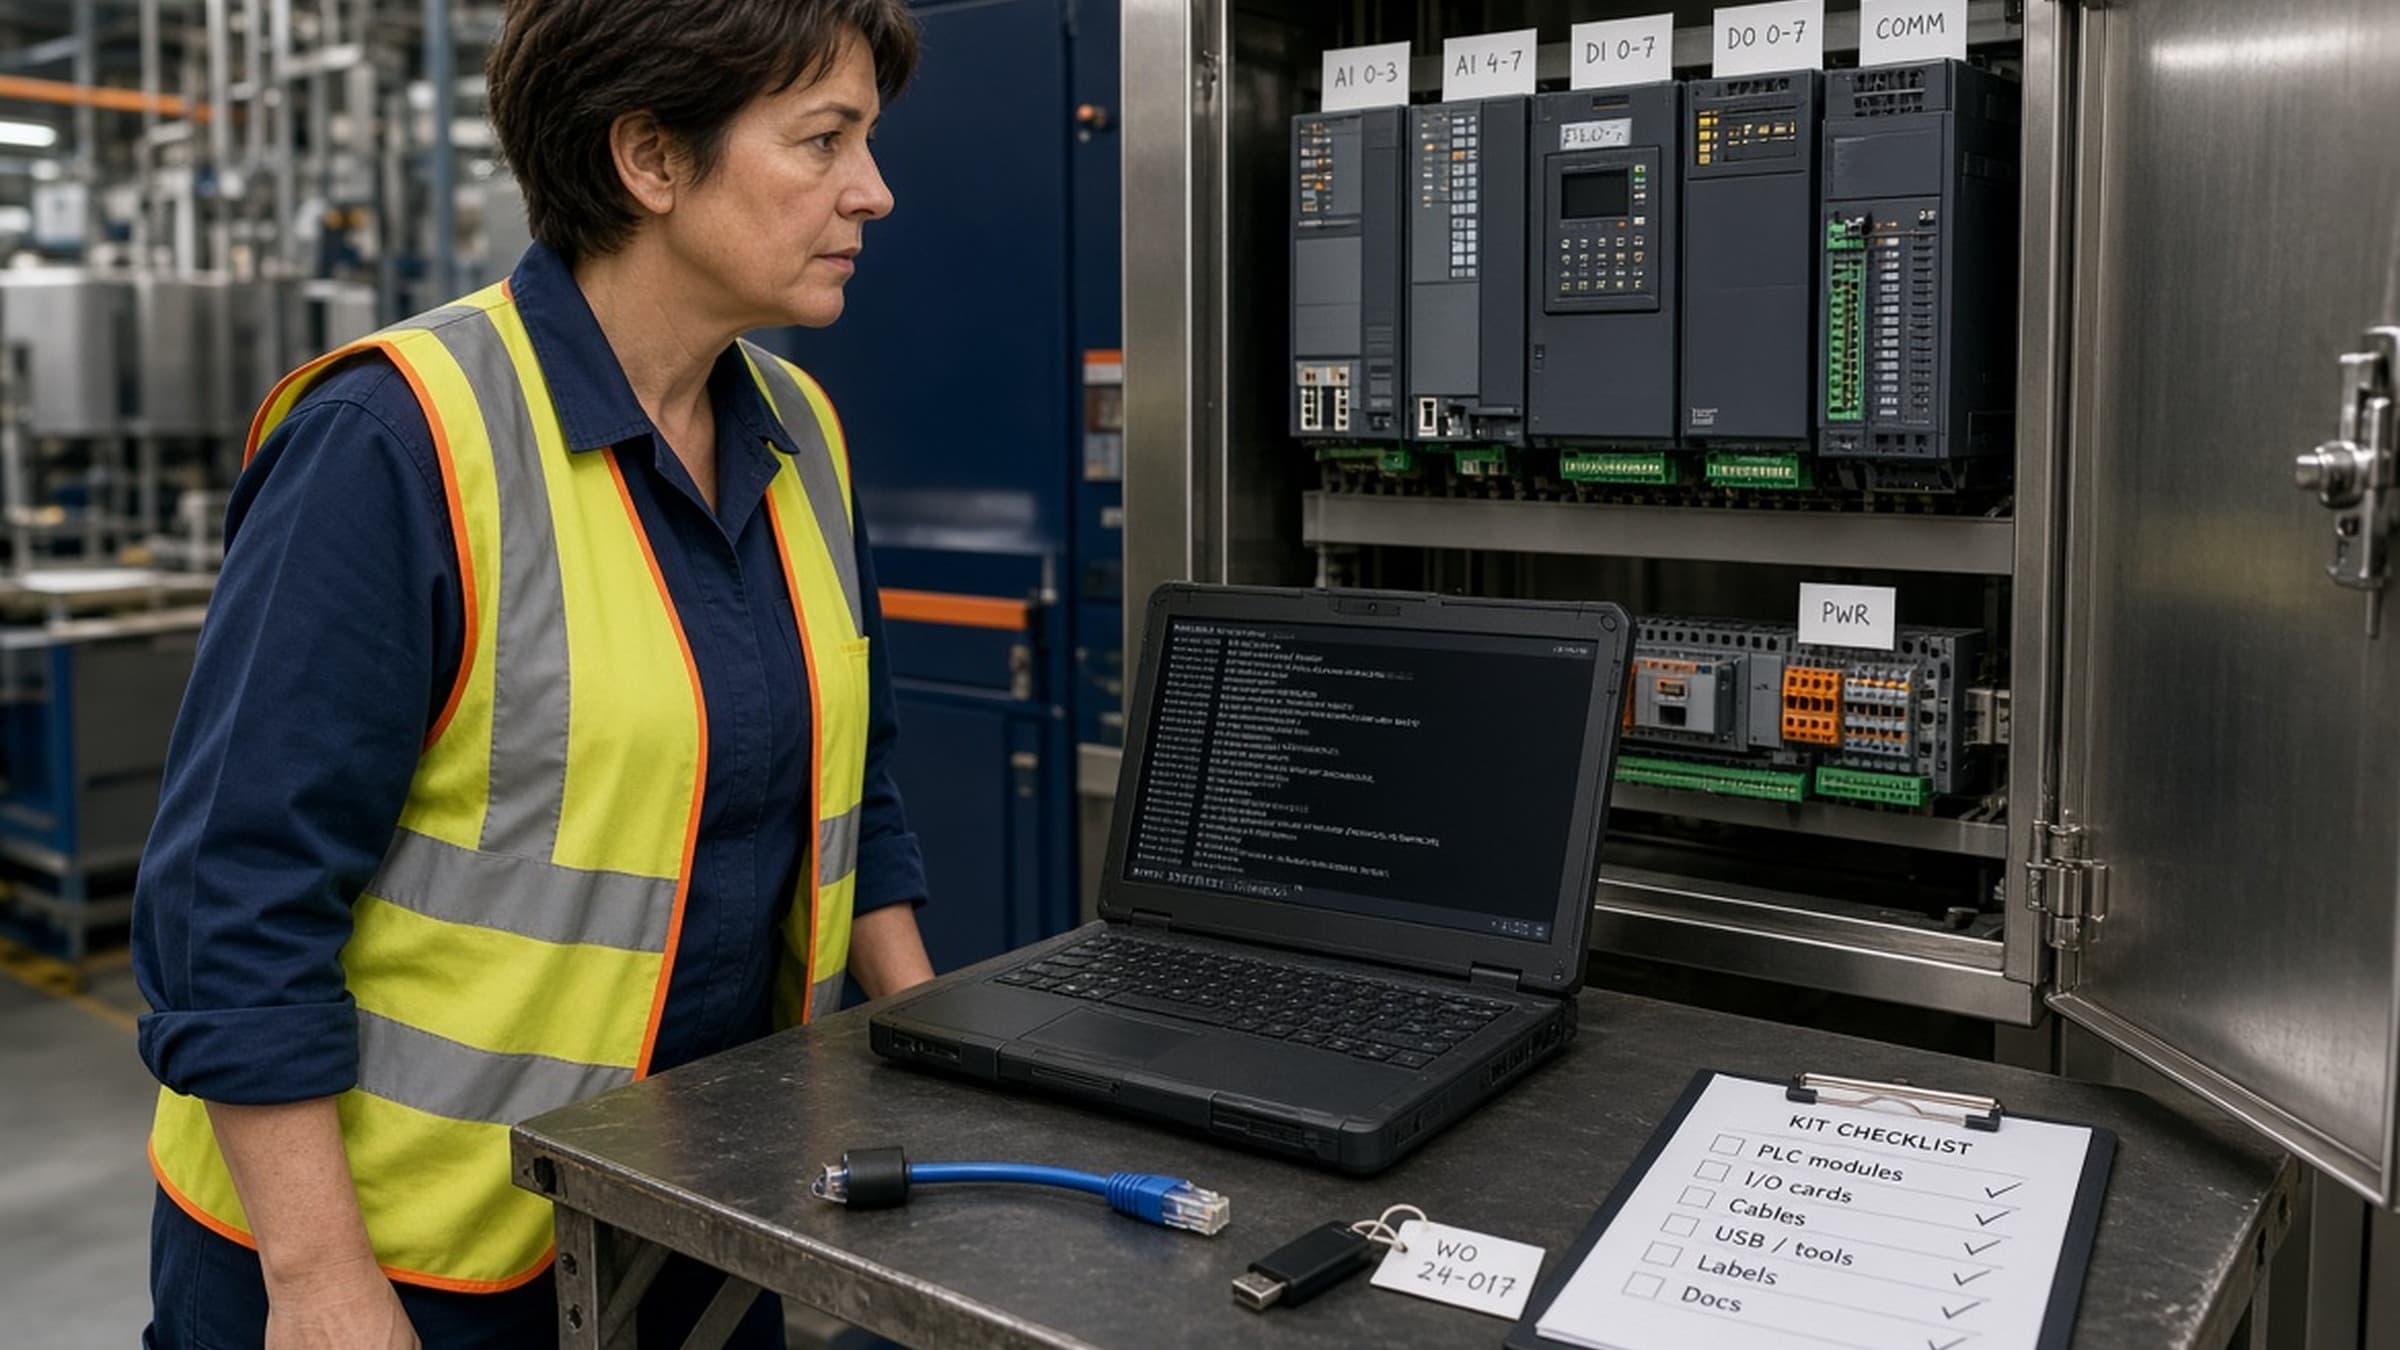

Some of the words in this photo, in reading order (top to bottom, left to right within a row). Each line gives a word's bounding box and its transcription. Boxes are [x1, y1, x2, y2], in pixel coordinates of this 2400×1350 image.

[1727, 26, 1756, 50] DO
[1766, 19, 1806, 45] 0-7
[1876, 12, 1945, 40] COMM
[1455, 54, 1476, 76] AI
[1486, 49, 1523, 74] 4-7
[1586, 41, 1606, 65] DI
[1616, 35, 1655, 60] 0-7
[1334, 65, 1354, 88] AI
[1363, 61, 1398, 85] 0-3
[1822, 600, 1871, 626] PWR
[1789, 1114, 1831, 1132] KIT
[1836, 1122, 1973, 1155] CHECKLIST
[1757, 1144, 1803, 1164] PLC
[1808, 1156, 1903, 1182] modules
[1744, 1170, 1783, 1190] I/O
[1789, 1183, 1852, 1204] cards
[1729, 1198, 1806, 1227] Cables
[1437, 1239, 1478, 1262] WO
[1715, 1225, 1766, 1249] USB
[1771, 1237, 1788, 1254] /
[1795, 1242, 1853, 1266] tools
[1417, 1261, 1517, 1298] 24-017
[1697, 1254, 1777, 1285] Labels
[1681, 1285, 1742, 1313] Docs
